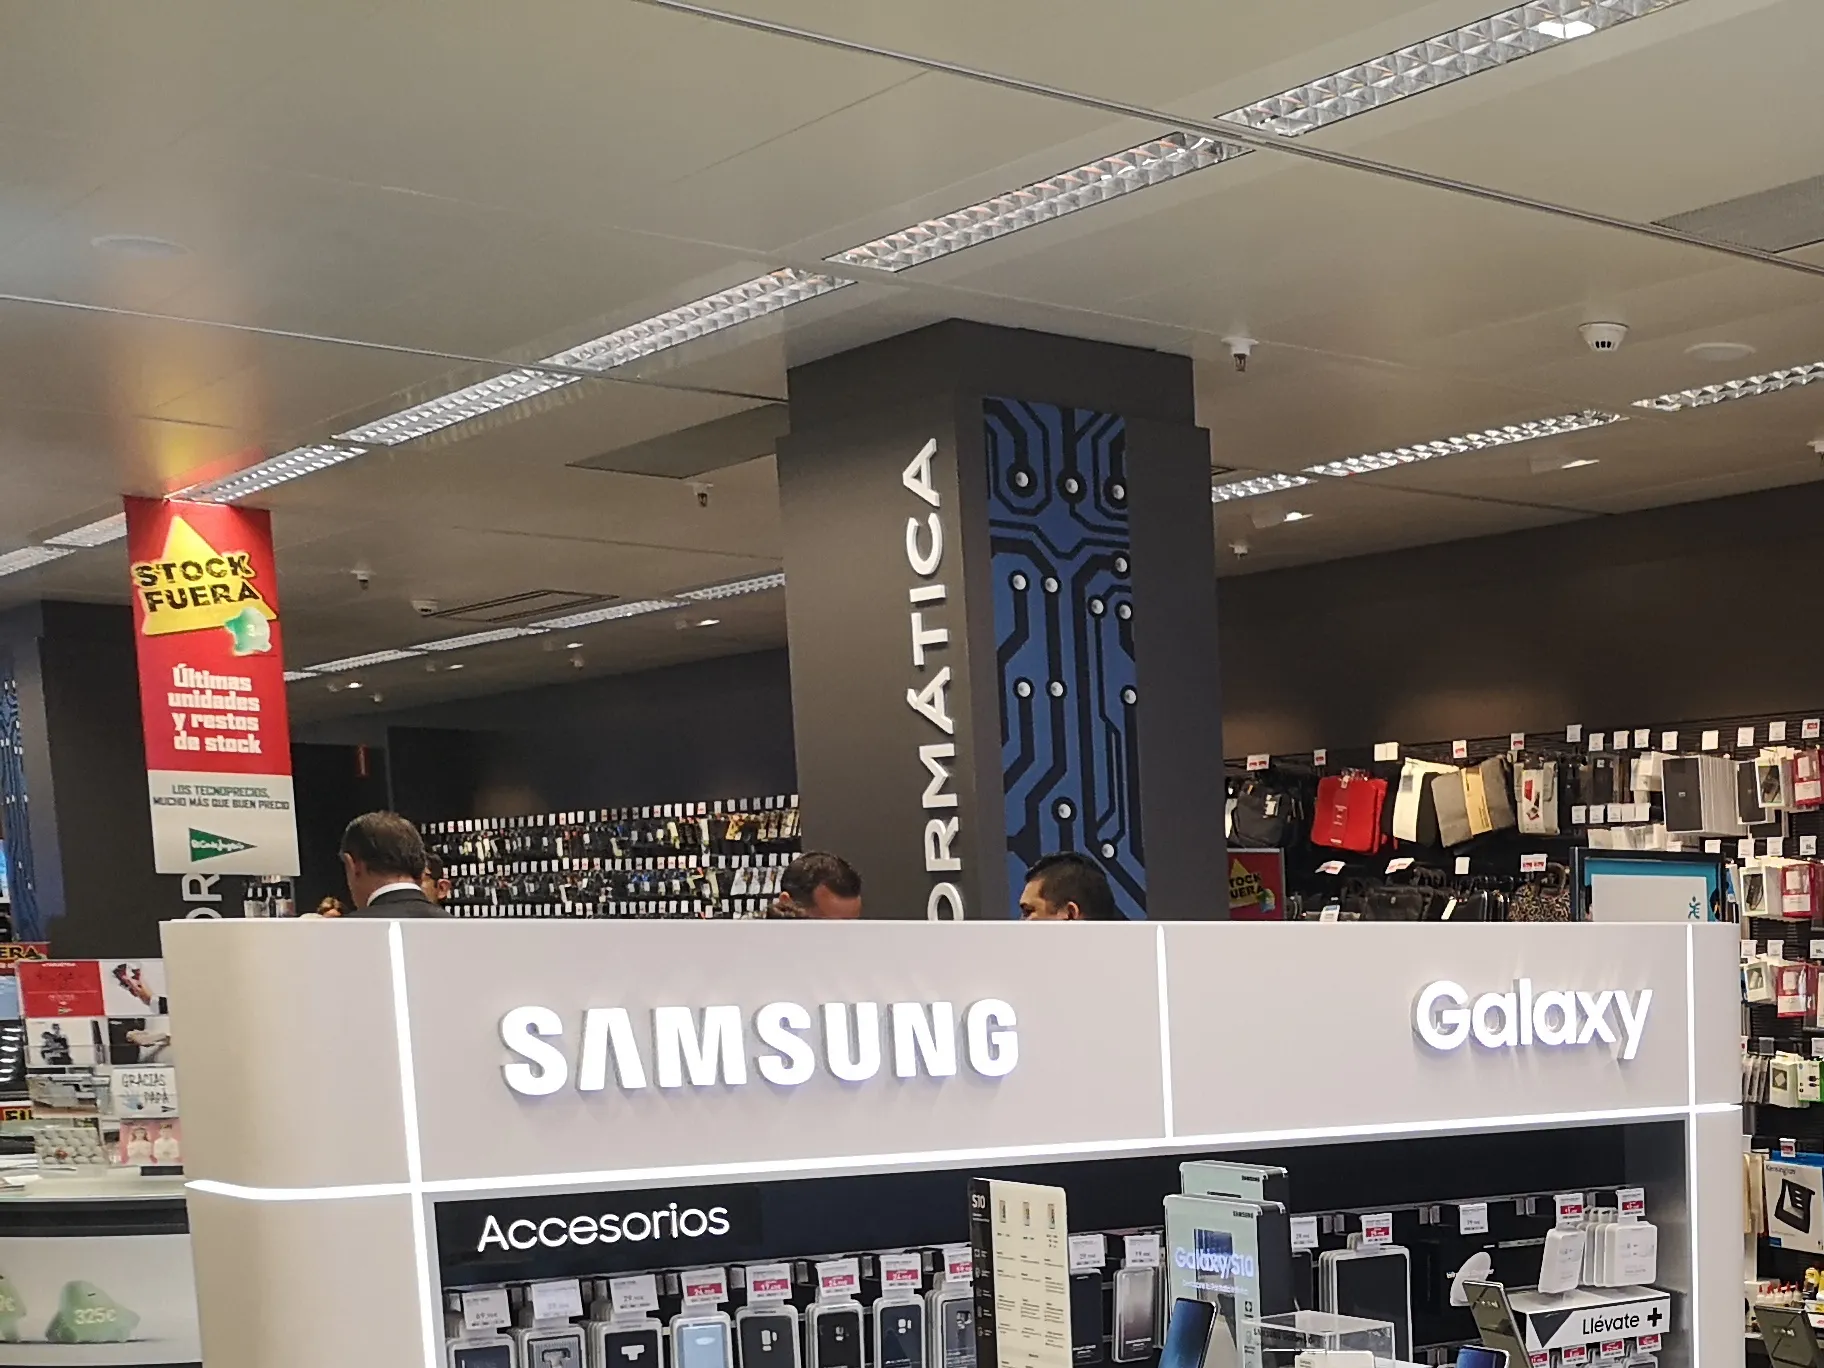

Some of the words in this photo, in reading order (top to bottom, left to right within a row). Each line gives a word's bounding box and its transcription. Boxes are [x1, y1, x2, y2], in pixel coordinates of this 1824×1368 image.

[135, 555, 251, 587] STOCK
[143, 580, 260, 612] FUERA
[172, 663, 252, 691] Últimas
[167, 690, 260, 711] unidades
[171, 712, 185, 731] y
[191, 713, 259, 731] restos
[174, 730, 200, 751] de
[204, 733, 262, 754] stock
[172, 784, 191, 795] LOS
[259, 800, 290, 810] PRECIO
[1414, 978, 1653, 1061] Galaxy
[501, 998, 1020, 1096] SAMSUNG
[122, 1073, 166, 1087] GRACIAS
[1765, 1165, 1796, 1176] Kensington
[972, 1194, 986, 1209] S10
[476, 1202, 731, 1252] Accesorios
[1582, 1313, 1640, 1335] Llévate
